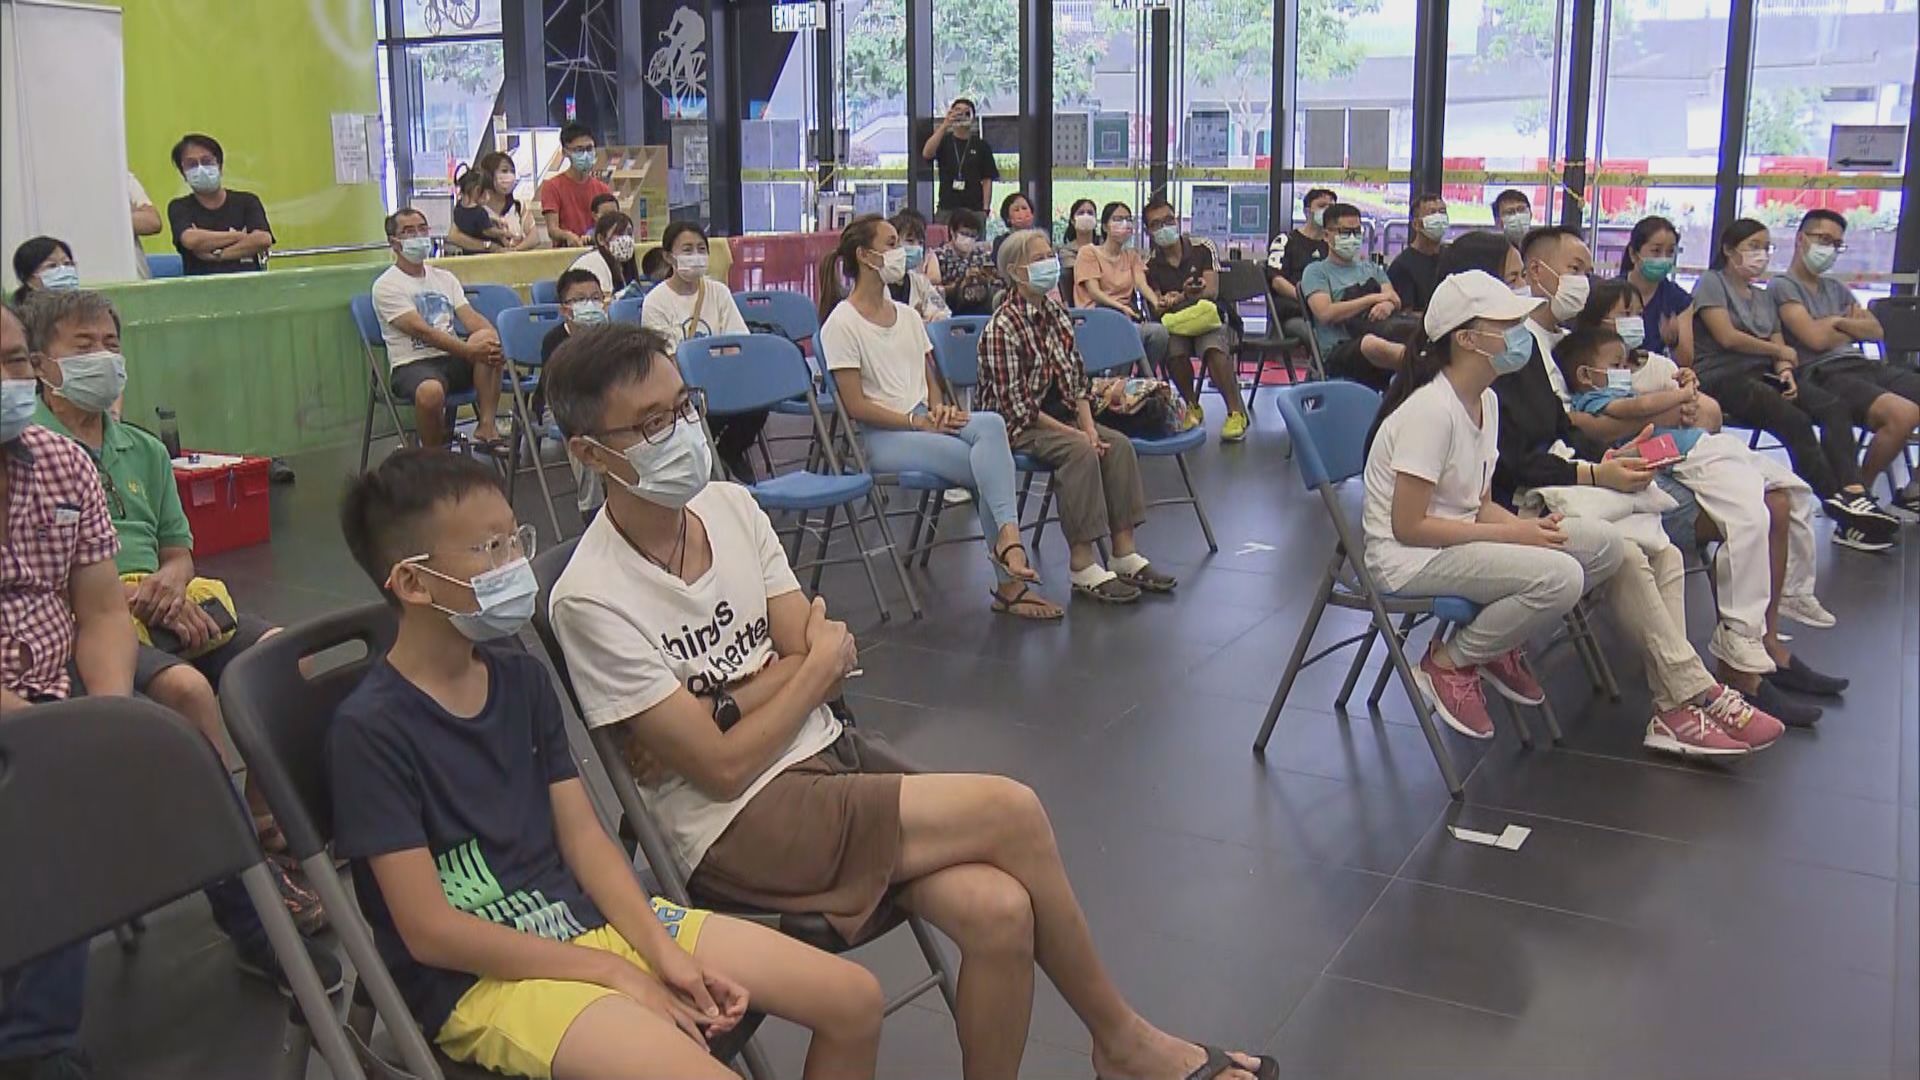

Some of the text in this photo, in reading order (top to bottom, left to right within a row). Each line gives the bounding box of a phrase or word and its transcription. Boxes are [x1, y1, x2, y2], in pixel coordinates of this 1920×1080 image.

[775, 5, 796, 30] EXIT
[798, 4, 816, 28] 出口
[661, 600, 734, 660] hings
